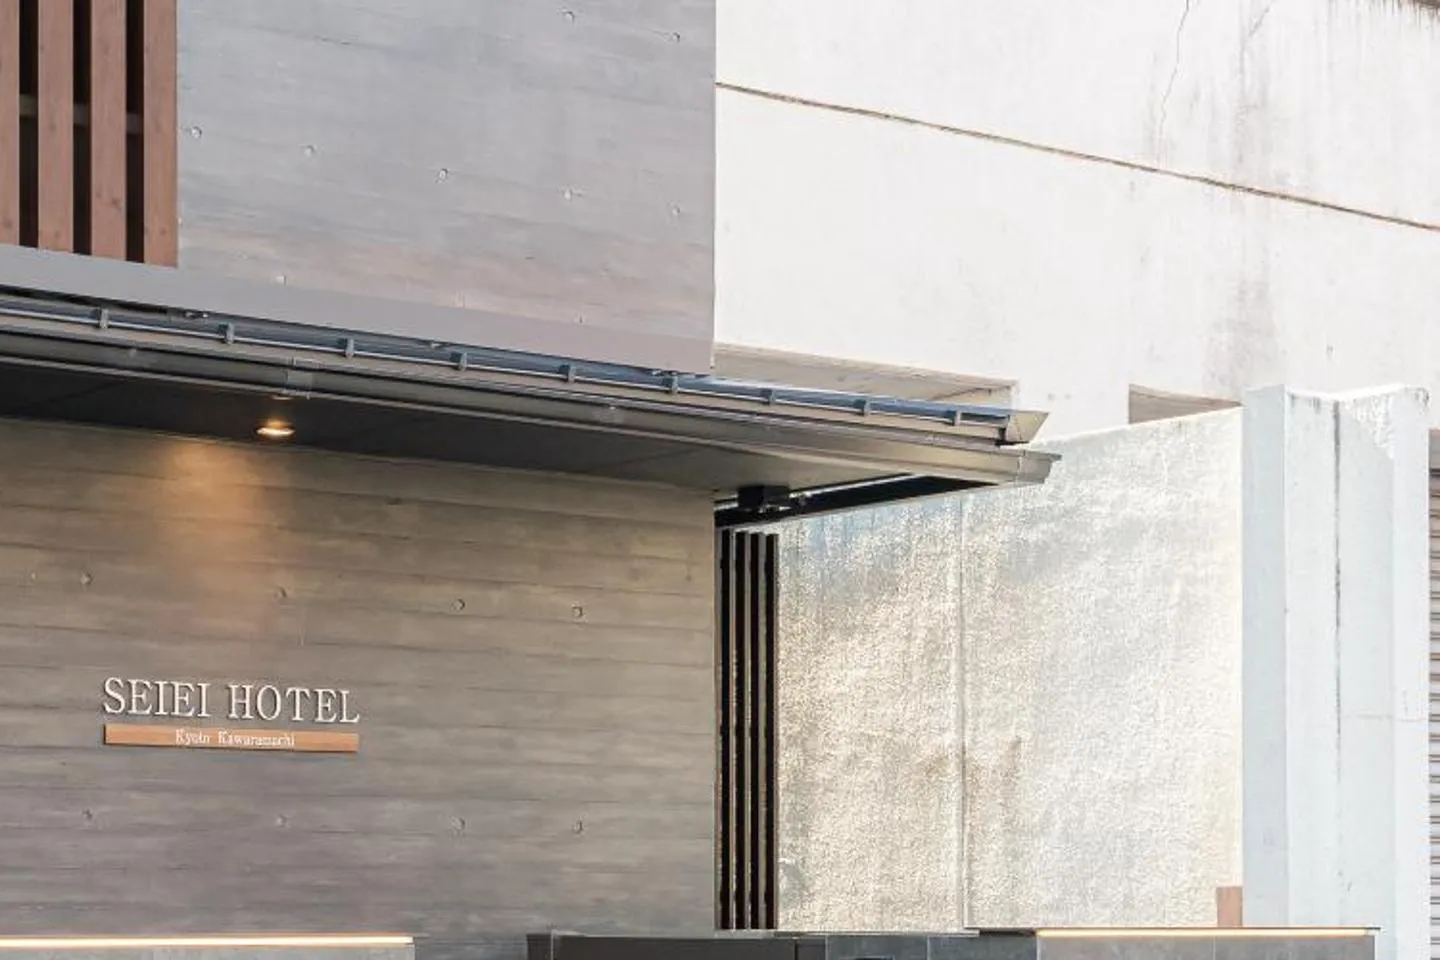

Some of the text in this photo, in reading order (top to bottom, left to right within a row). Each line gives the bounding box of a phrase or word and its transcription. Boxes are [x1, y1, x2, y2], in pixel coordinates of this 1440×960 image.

[104, 677, 360, 723] SEIEI HOTEL
[175, 728, 210, 745] Kyoto
